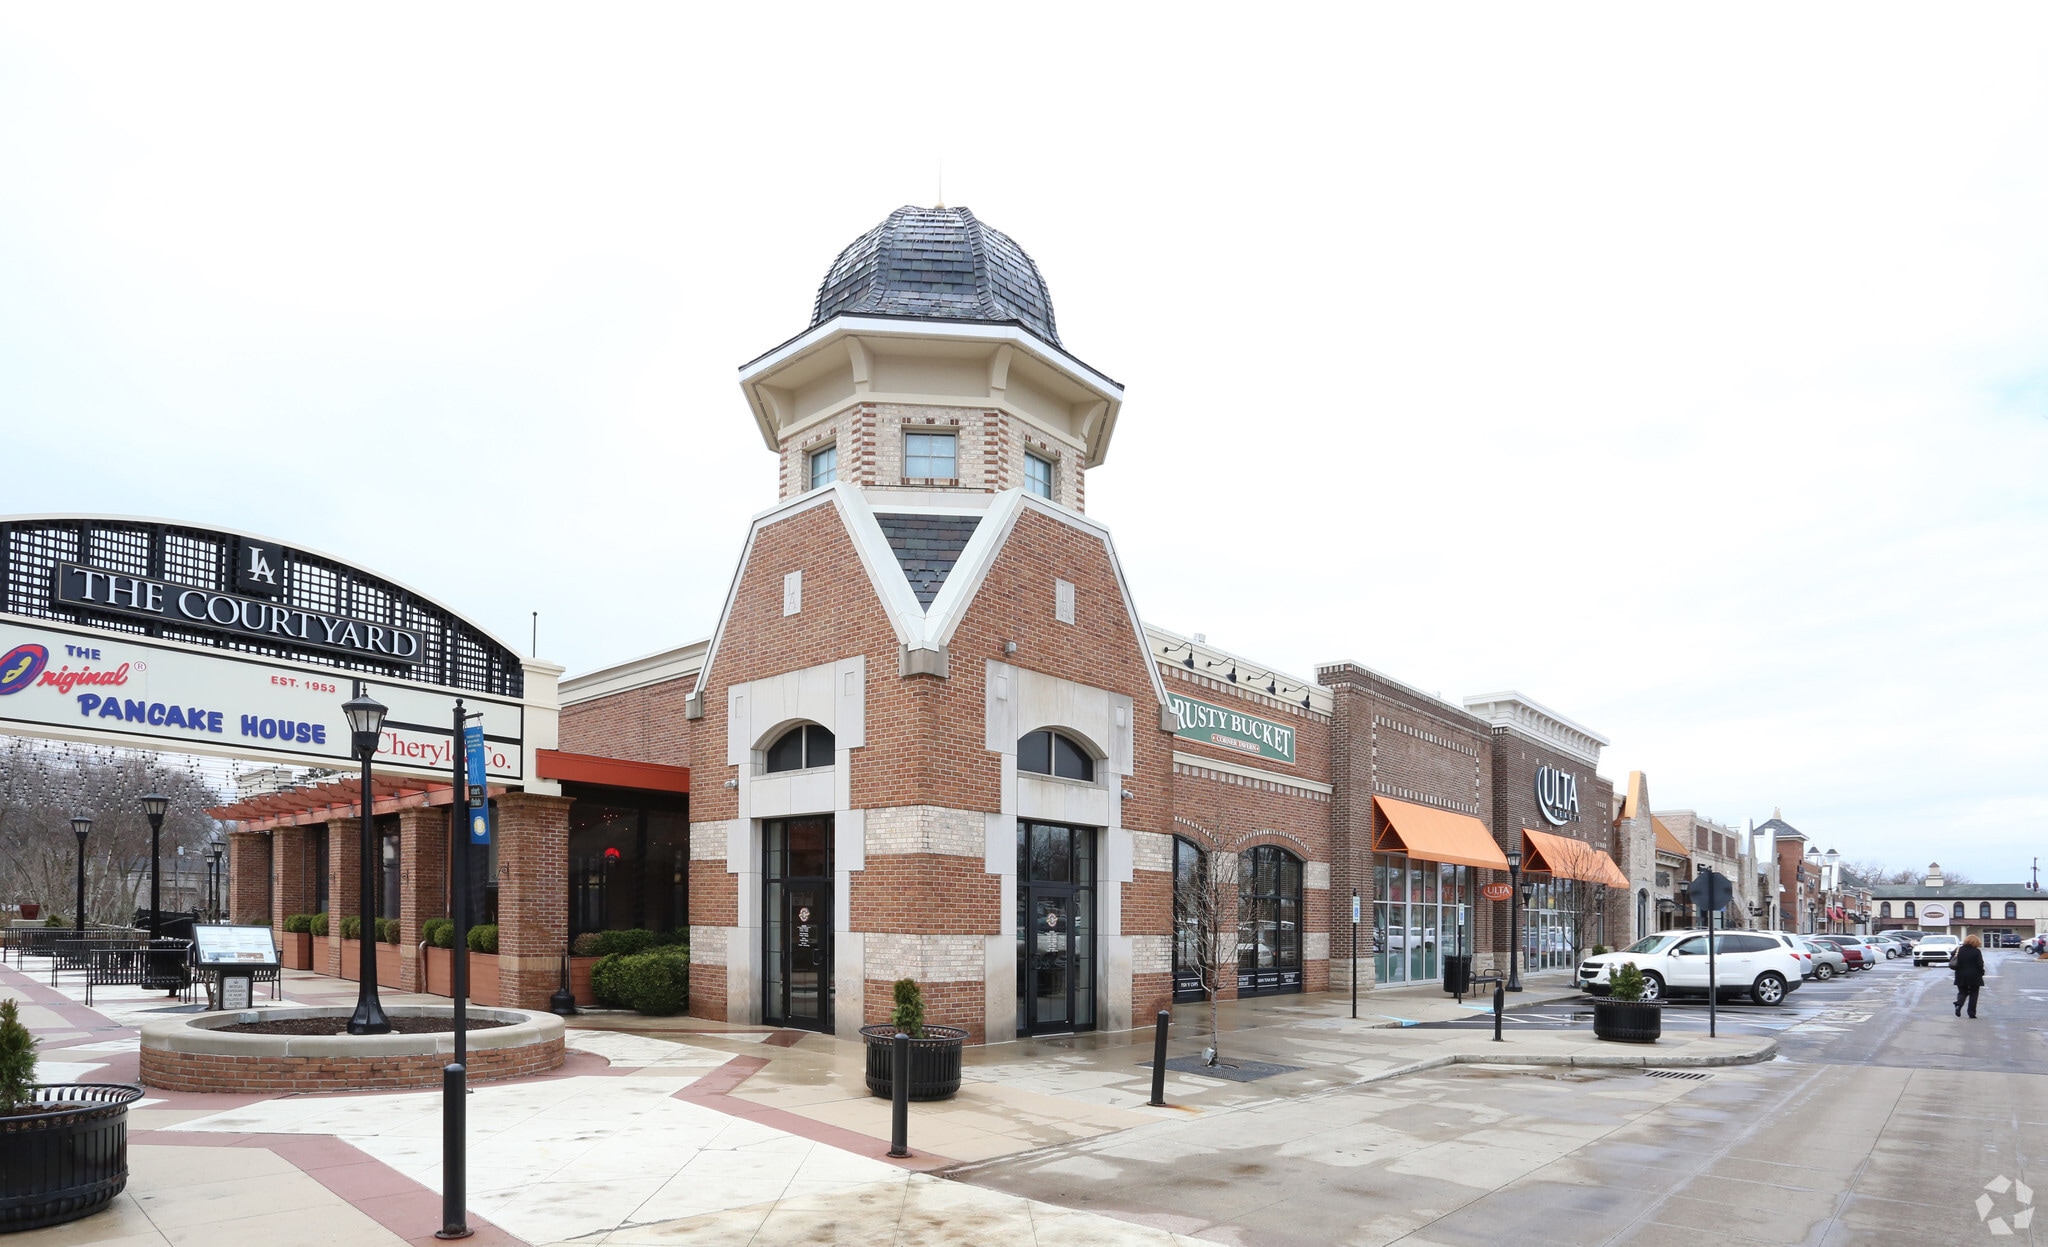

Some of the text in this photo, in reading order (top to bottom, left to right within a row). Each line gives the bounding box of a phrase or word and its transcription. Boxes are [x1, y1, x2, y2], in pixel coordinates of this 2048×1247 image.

[73, 568, 417, 657] THE COURTYARD
[65, 644, 101, 660] THE
[270, 675, 336, 693] EST. 1953
[77, 693, 326, 744] PANCAKE HOUSE
[1173, 698, 1291, 758] RUSTY BUCKET
[1544, 766, 1579, 813] ULTA
[1487, 886, 1510, 894] ULTA
